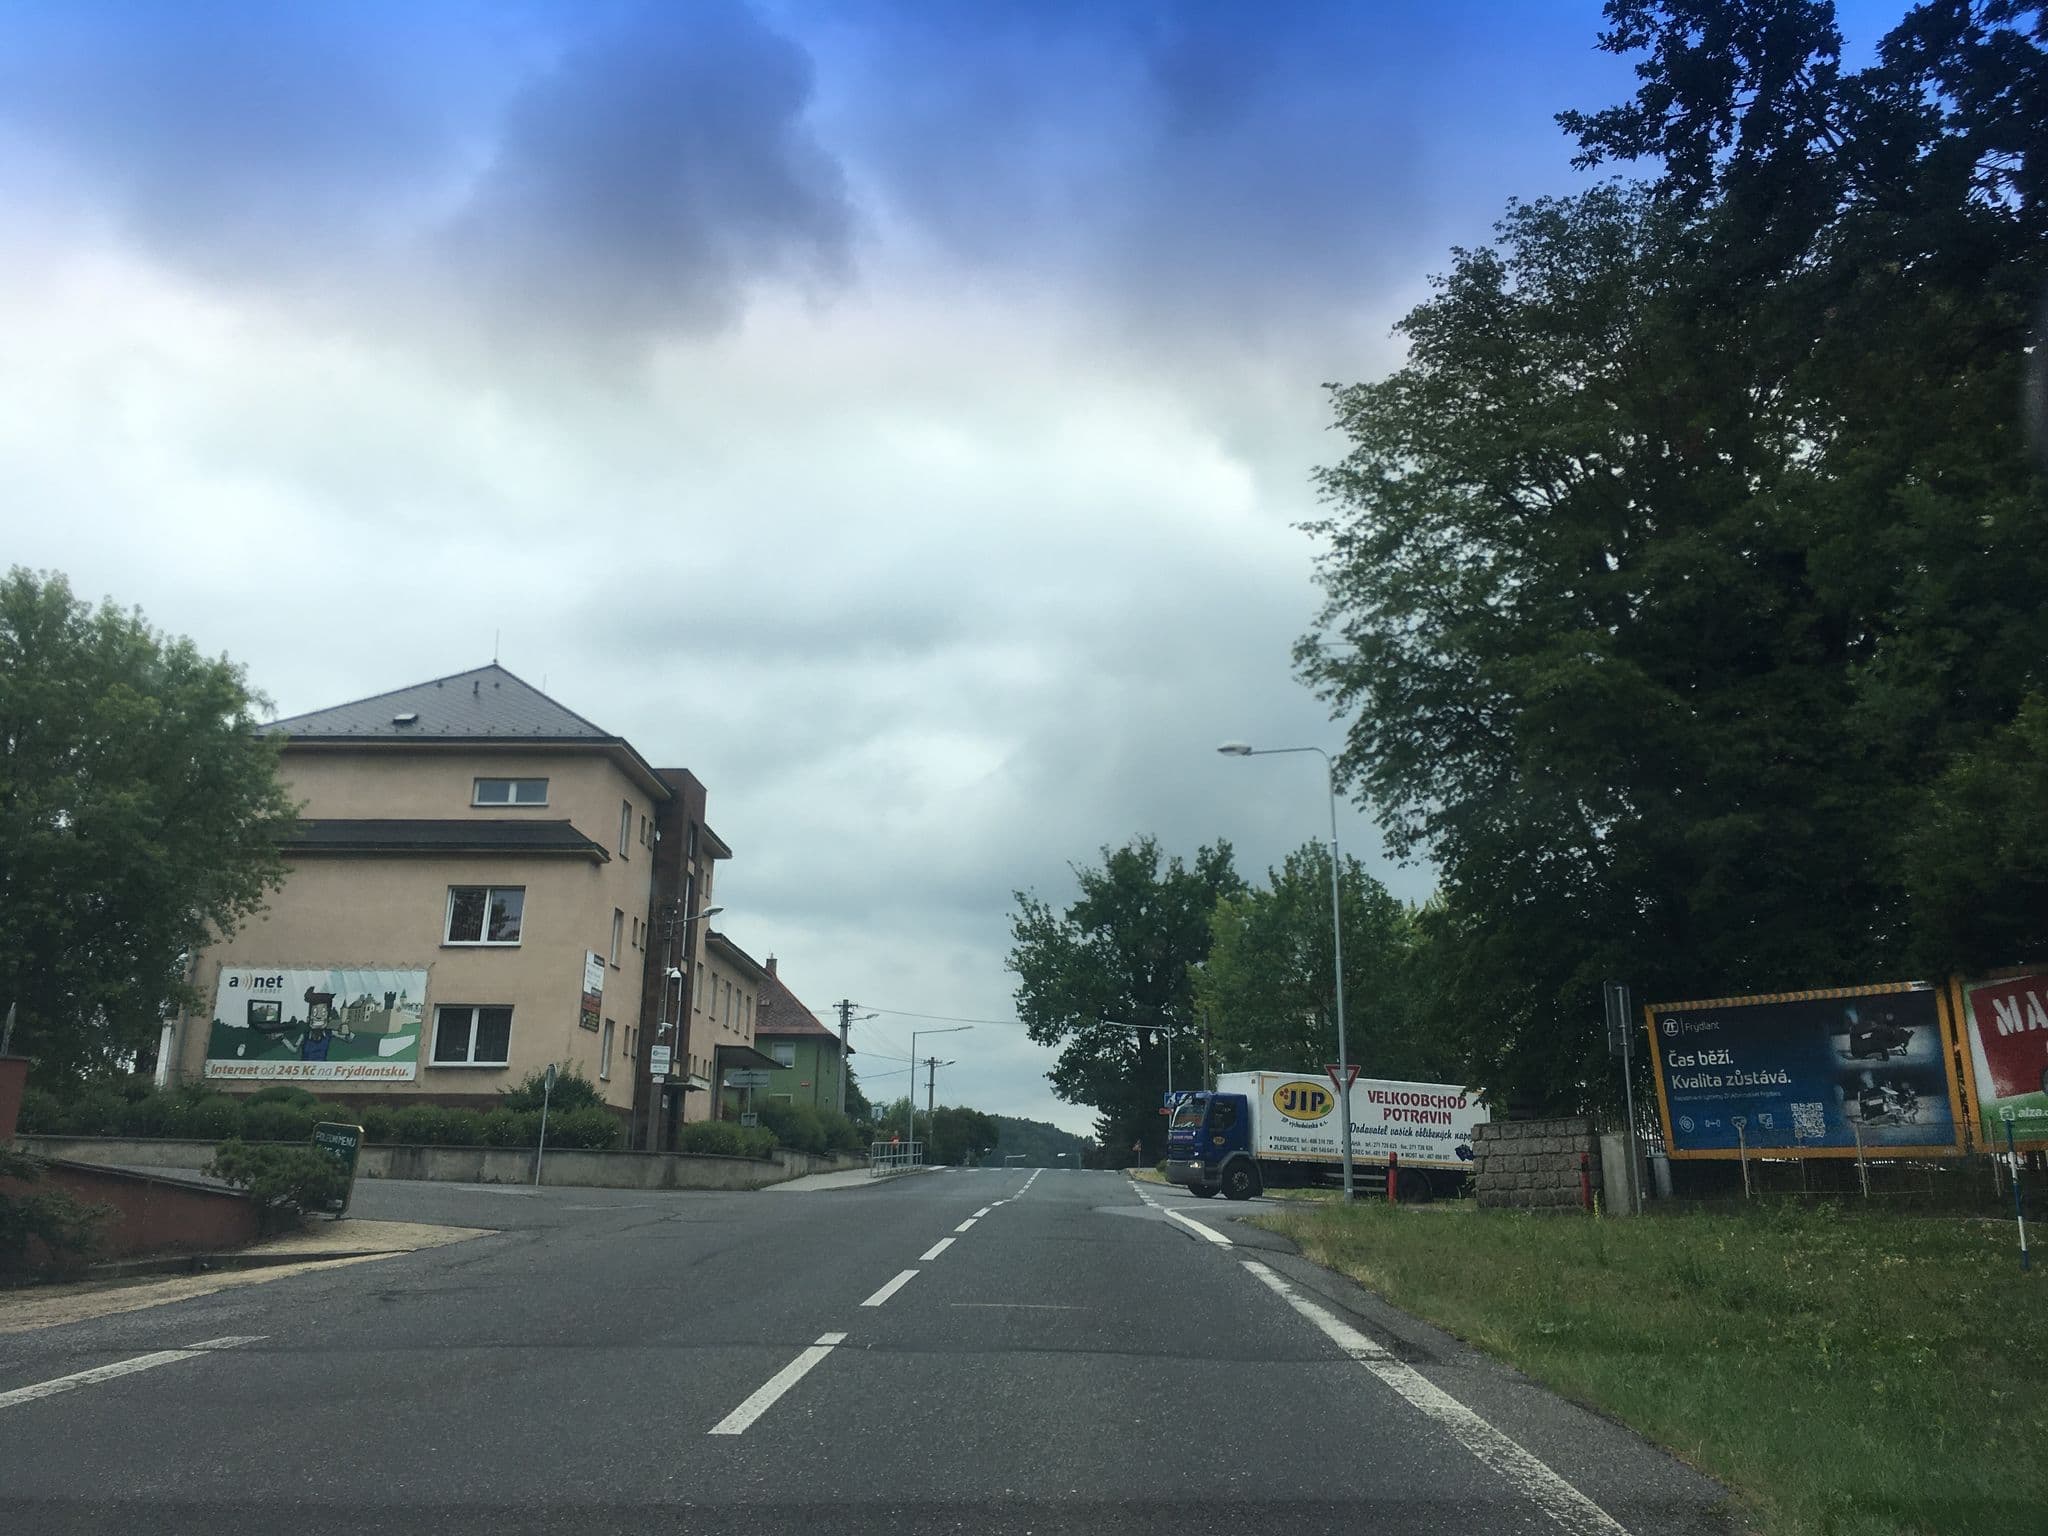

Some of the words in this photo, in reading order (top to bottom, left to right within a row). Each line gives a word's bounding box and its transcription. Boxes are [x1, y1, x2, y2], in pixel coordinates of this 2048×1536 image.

[1992, 990, 2048, 1036] MA
[1668, 1050, 1695, 1068] Čas
[1698, 1048, 1734, 1066] běží.
[211, 1064, 259, 1075] Internet
[261, 1065, 274, 1075] od
[277, 1065, 300, 1075] 245
[301, 1064, 315, 1075] Kč
[317, 1067, 332, 1076] na
[334, 1065, 409, 1078] Frýdlantsku.
[1671, 1074, 1722, 1089] Kvalita
[1725, 1069, 1792, 1087] zůstává.
[1285, 1090, 1325, 1112] JIP
[1368, 1090, 1467, 1109] VELKOOBCHOD
[1383, 1108, 1452, 1124] POTRAVIN
